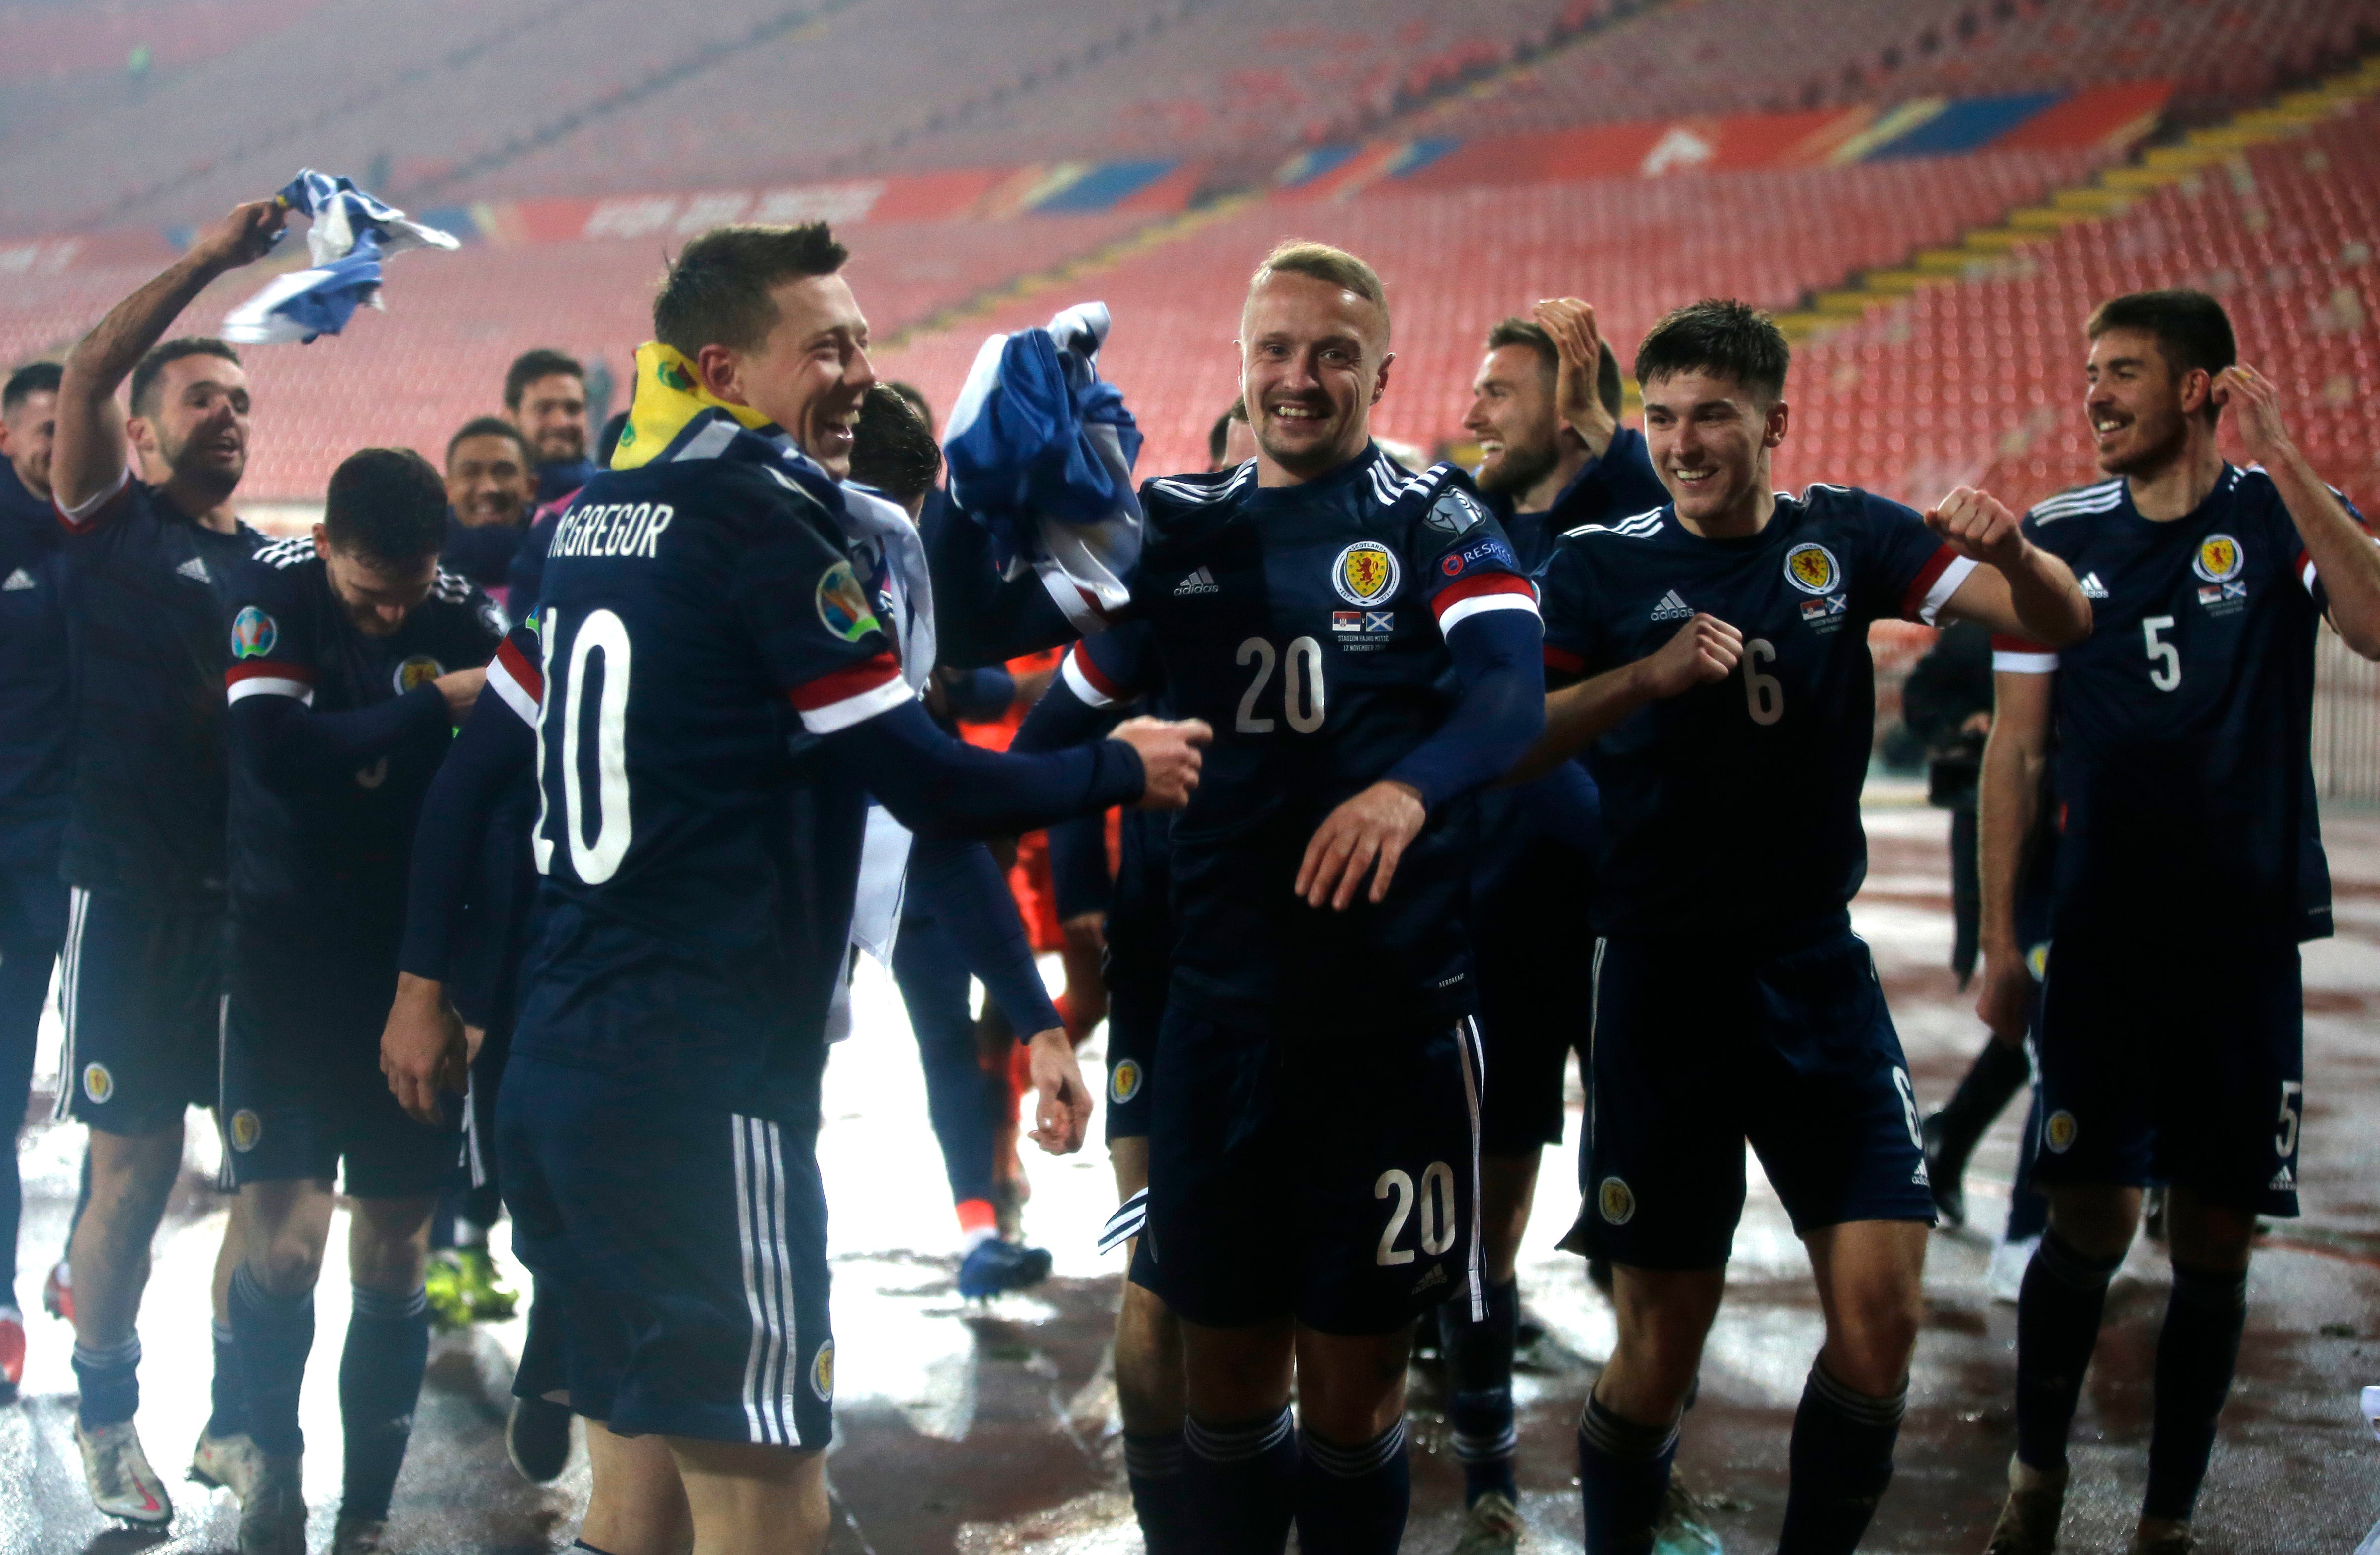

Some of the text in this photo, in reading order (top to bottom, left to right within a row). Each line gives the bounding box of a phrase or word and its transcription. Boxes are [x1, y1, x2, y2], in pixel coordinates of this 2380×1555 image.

[1174, 584, 1219, 596] adidas
[1340, 590, 1349, 599] EST
[1651, 608, 1694, 621] adidas
[1235, 636, 1325, 733] 20
[1742, 638, 1784, 726] 6
[2143, 616, 2181, 691] 5
[1892, 1066, 1923, 1150] 6
[2276, 1081, 2301, 1158] 5
[1375, 1161, 1455, 1266] 20
